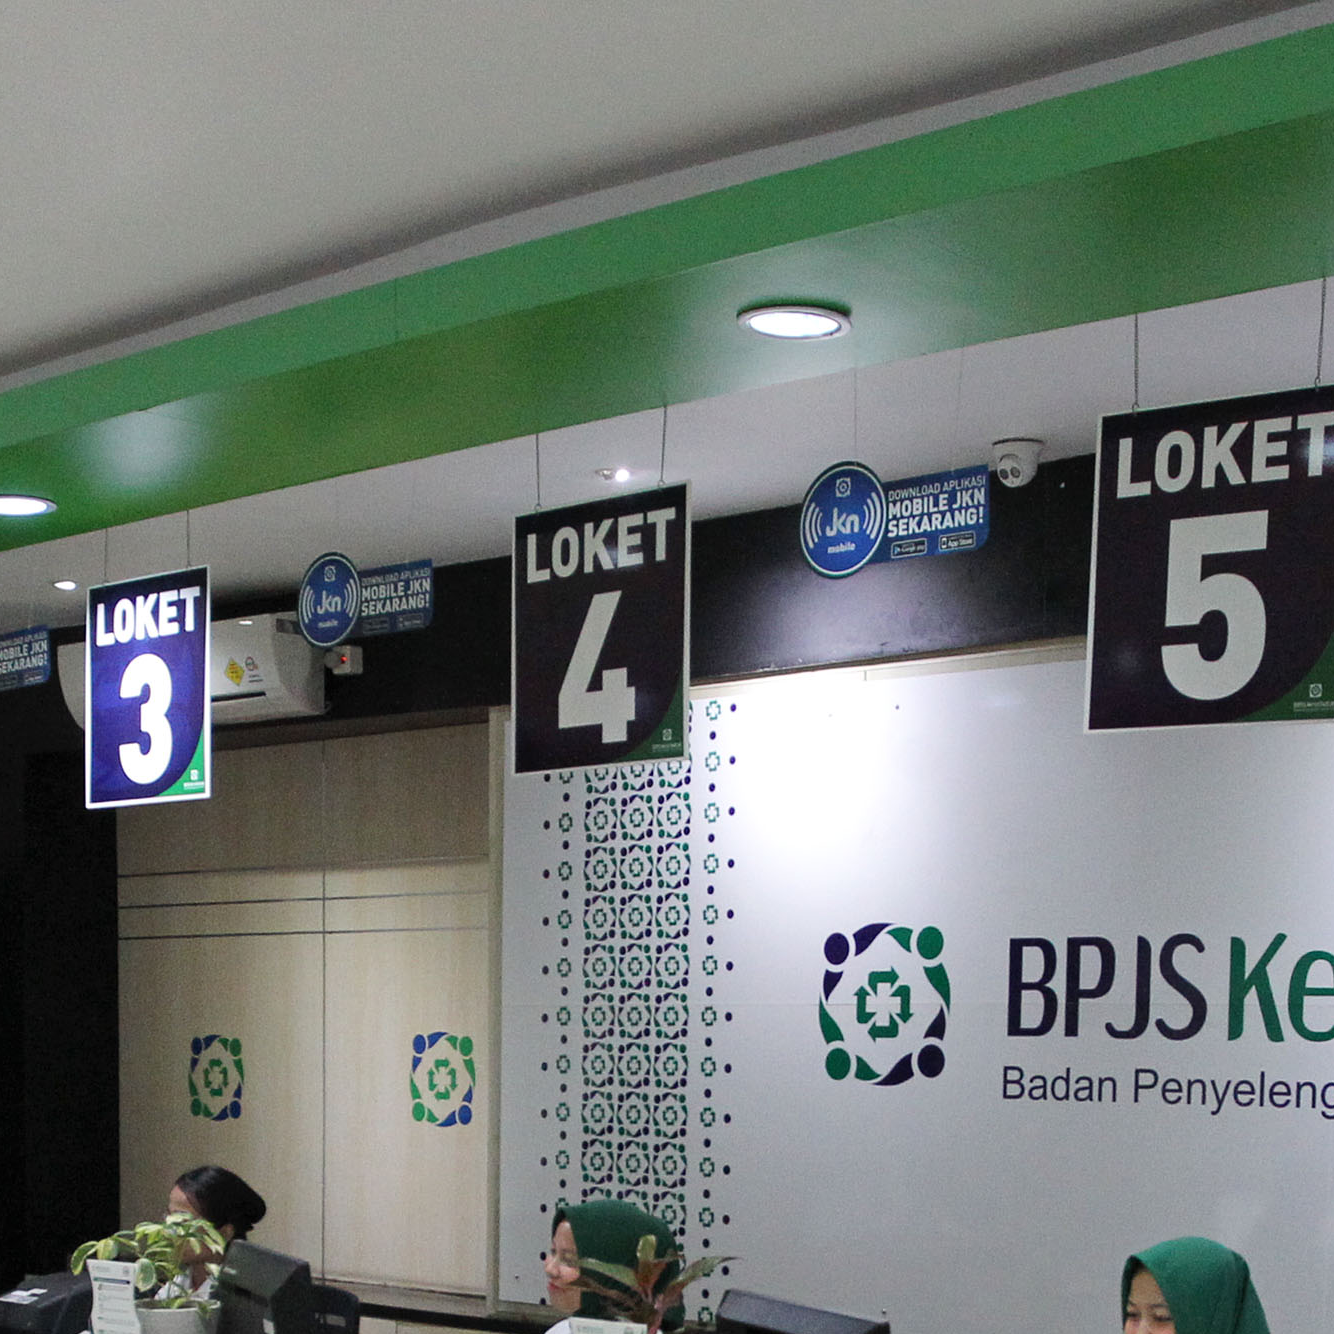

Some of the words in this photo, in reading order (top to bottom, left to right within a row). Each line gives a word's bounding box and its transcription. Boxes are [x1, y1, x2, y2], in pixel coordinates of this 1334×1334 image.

[888, 483, 941, 501] DOWNLOAD
[942, 475, 986, 491] APLIKASI
[888, 494, 948, 519] MOBILE
[952, 487, 985, 509] JKN
[887, 506, 984, 537] SEKARANG!
[526, 506, 676, 585] LOKET
[827, 542, 856, 554] mobile
[361, 593, 430, 616] SEKARANG!
[362, 582, 405, 601] MOBILE
[407, 578, 430, 593] JKN
[1161, 509, 1269, 701] 5
[95, 586, 201, 647] LOKET
[30, 640, 48, 654] JKN
[558, 590, 636, 745] 4
[118, 653, 173, 785] 3
[1007, 932, 1208, 1041] BPJS
[1002, 1066, 1117, 1103] Badan
